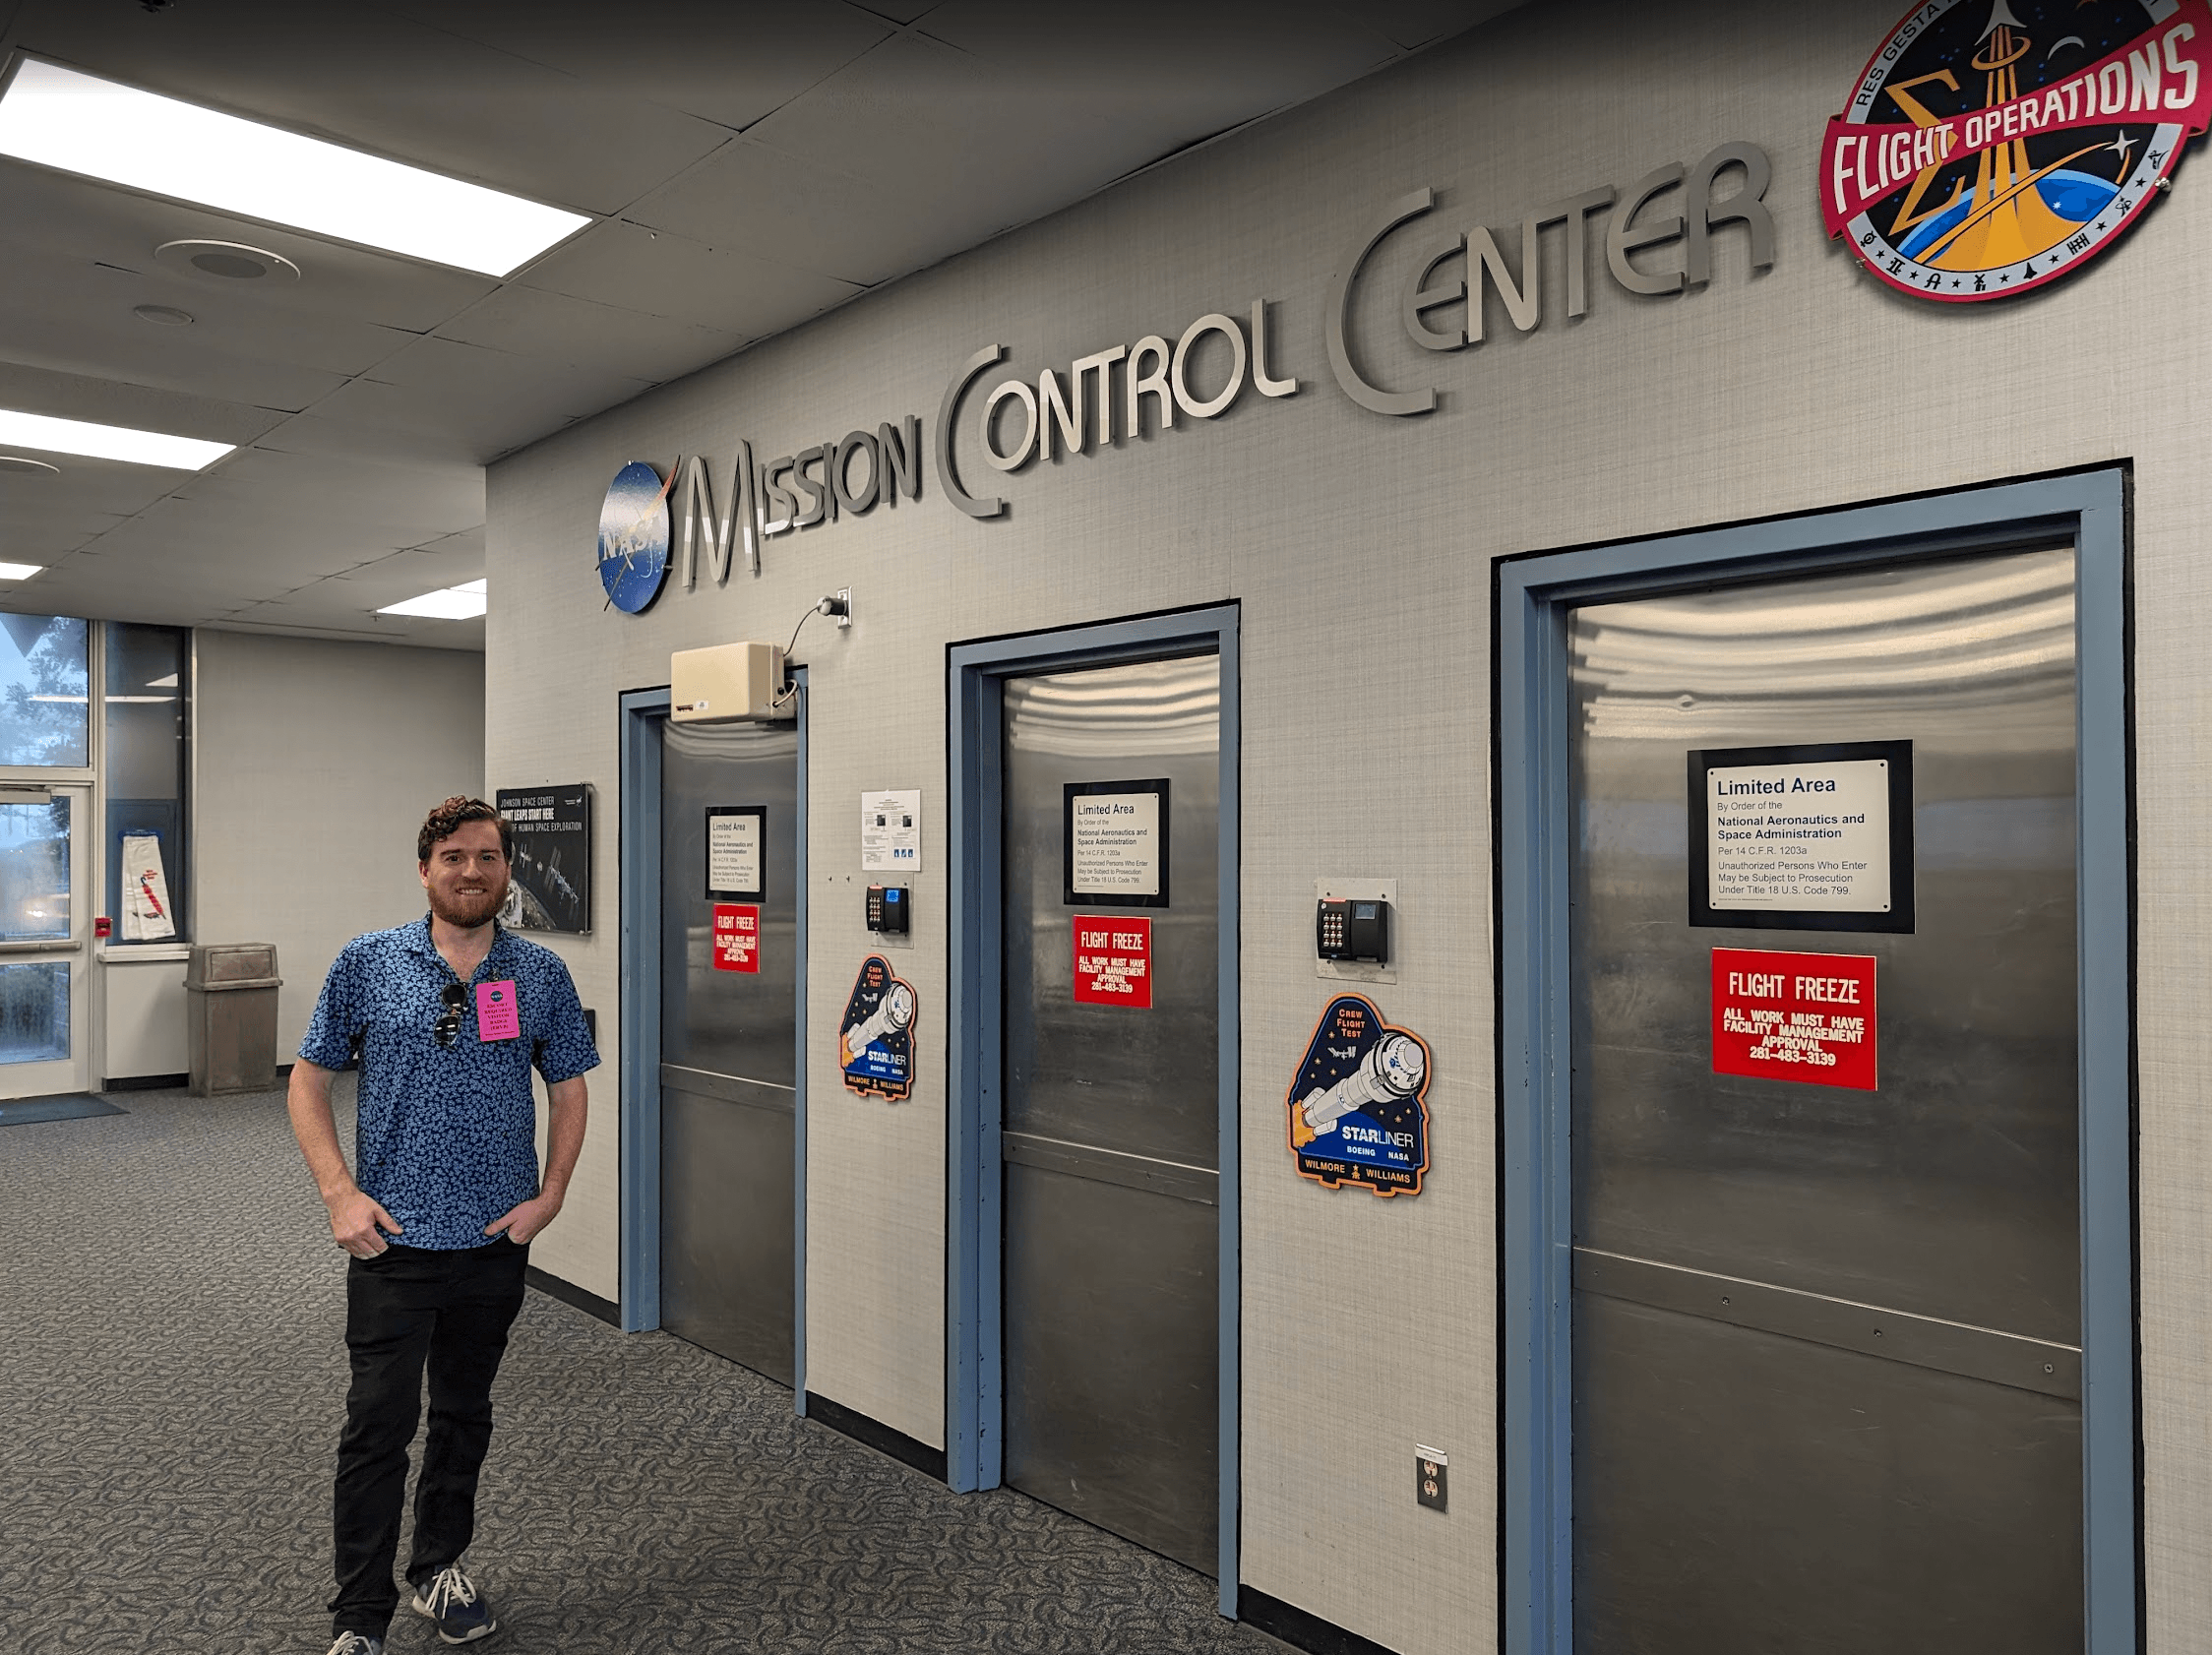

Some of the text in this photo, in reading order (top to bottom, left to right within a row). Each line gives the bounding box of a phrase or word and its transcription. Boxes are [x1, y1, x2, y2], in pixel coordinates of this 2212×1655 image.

[1856, 4, 1939, 105] RES GESTA
[1833, 23, 2199, 215] FLIGHT OPERATIONS
[603, 516, 663, 571] NASA
[1718, 778, 1836, 795] Limited Area
[522, 797, 536, 807] SPACE
[1077, 804, 1135, 815] Limited Area
[1717, 803, 1728, 812] By
[1757, 801, 1767, 810] of
[535, 823, 549, 831] SPACE
[1718, 814, 1865, 826] National Aeronautics and
[1718, 828, 1842, 841] Space Administration
[1718, 874, 1737, 884] May
[1739, 874, 1749, 883] be
[1751, 874, 1785, 884] Subject
[1799, 874, 1853, 883] Prosecution
[718, 915, 754, 930] FLIGHT FREEZE
[1080, 932, 1143, 950] FLIGHT FREEZE
[1078, 955, 1089, 964] ALL
[1091, 956, 1108, 965] WORK
[1130, 958, 1145, 968] HAVE
[1105, 966, 1144, 977] MANAGEMENT
[1730, 972, 1860, 1004] FLIGHT FREEZE
[1339, 1009, 1363, 1018] CREW
[1724, 1008, 1864, 1030] ALL WORK MUST HAVE
[1337, 1018, 1366, 1028] FLIGHT
[1341, 1028, 1362, 1038] TEST
[1724, 1019, 1864, 1043] FACILITY MANAGEMENT
[1761, 1036, 1822, 1052] APPROVAL
[868, 1051, 906, 1066] STARLINER
[1750, 1046, 1836, 1066] 281-483-3139
[1342, 1126, 1414, 1148] STARLINER
[1347, 1146, 1409, 1161] BOEING NASA
[1306, 1159, 1411, 1183] WILMORE WILLIAMS
